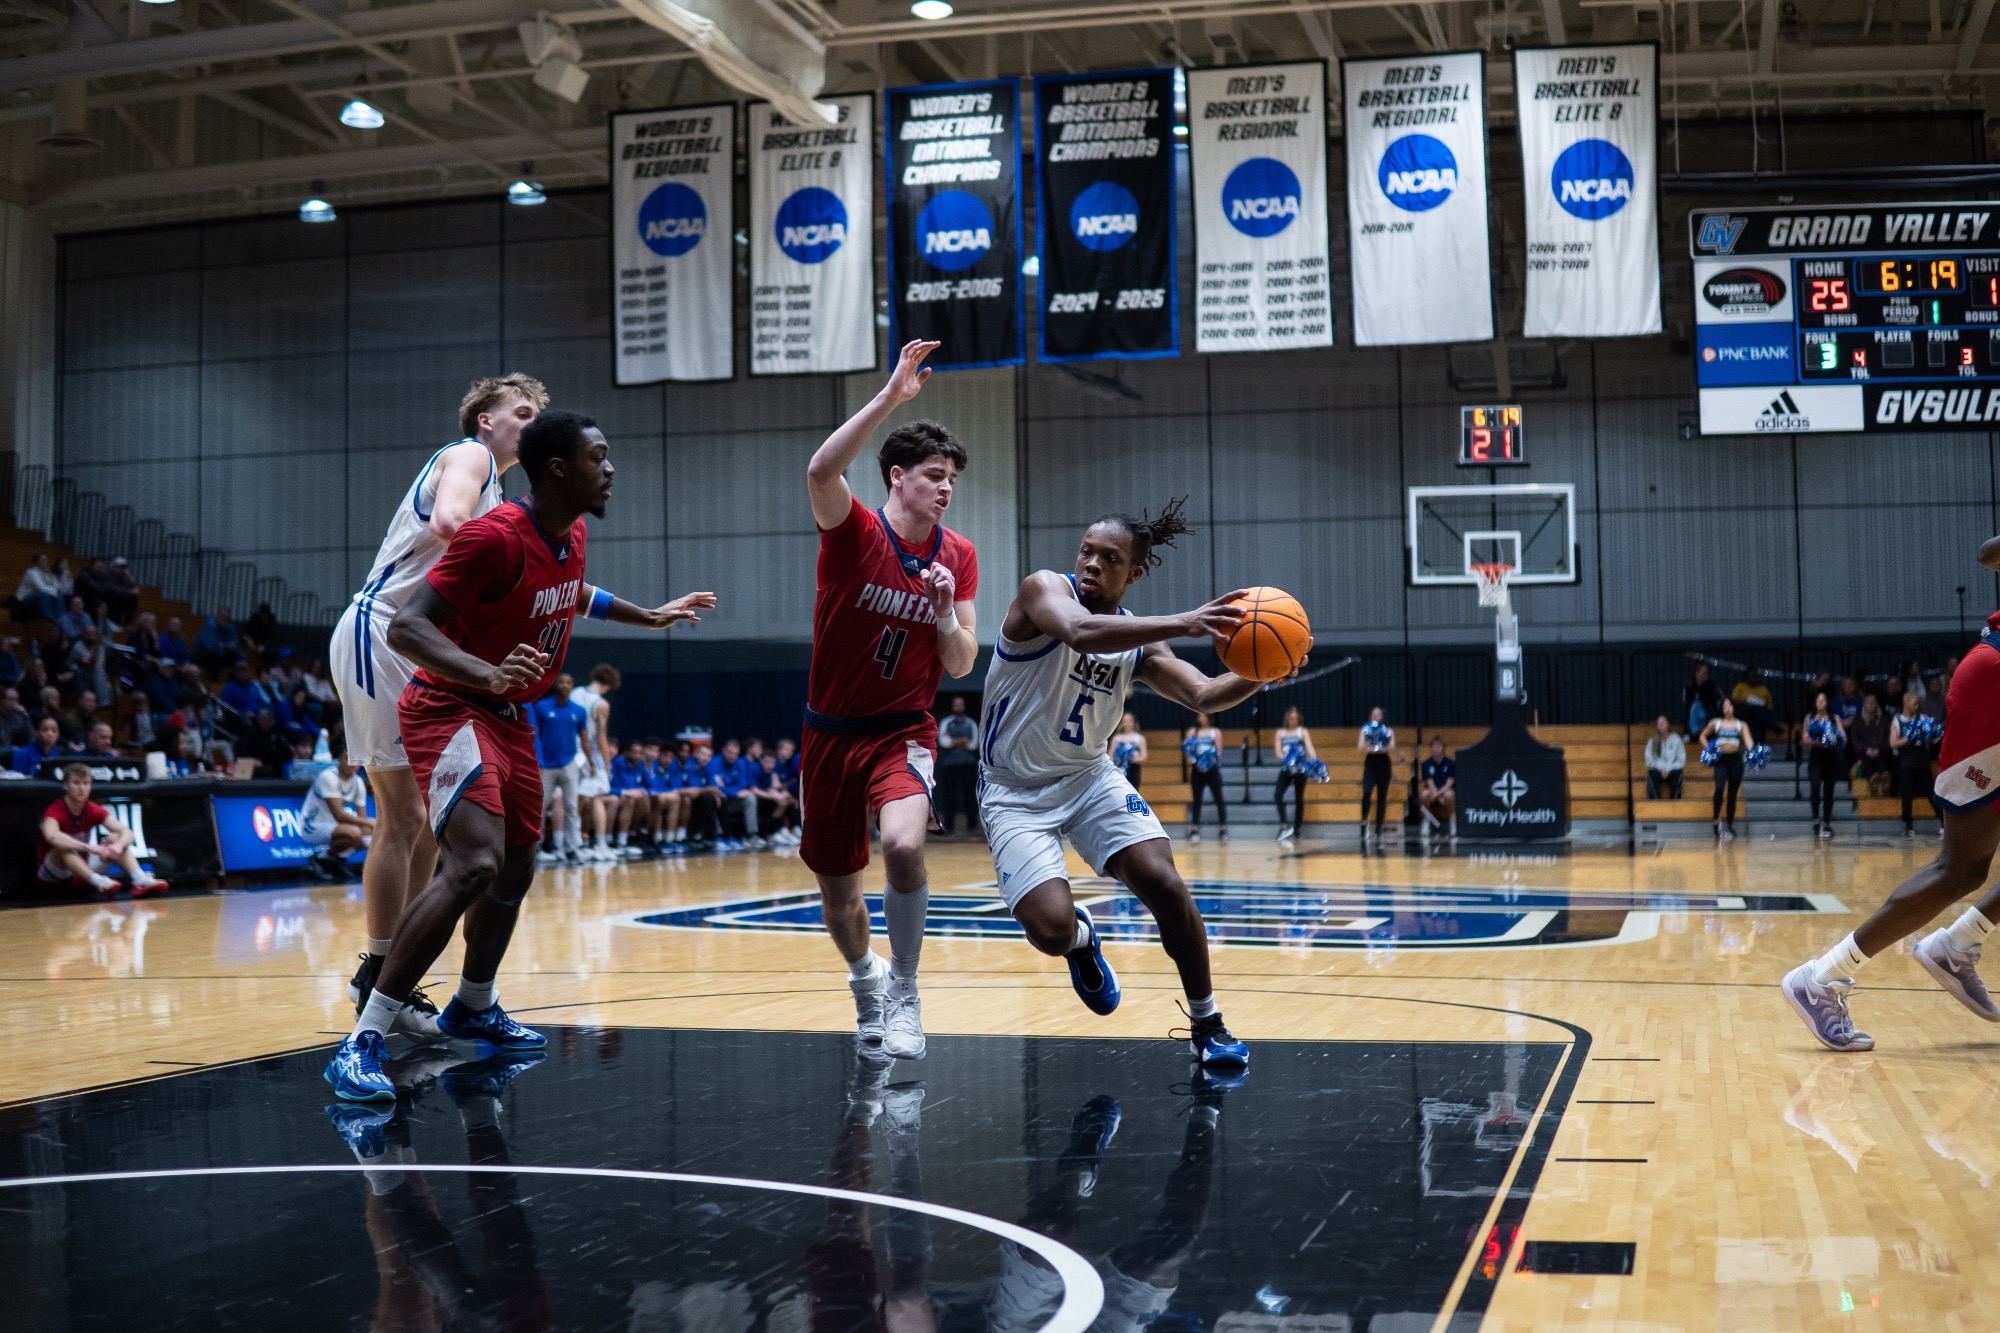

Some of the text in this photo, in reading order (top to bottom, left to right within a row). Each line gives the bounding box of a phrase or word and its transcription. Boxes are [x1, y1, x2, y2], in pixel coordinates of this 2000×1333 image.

[1383, 65, 1442, 85] MEN'S
[1557, 56, 1616, 76] MEN'S
[1063, 82, 1149, 102] WOMEN'S
[1226, 74, 1286, 95] MEN'S
[1358, 84, 1470, 107] BASKETBALL
[1534, 79, 1641, 100] BASKETBALL
[910, 93, 992, 117] WOMEN'S
[1049, 101, 1159, 124] BASKETBALL
[1204, 97, 1312, 119] BASKETBALL
[1554, 102, 1623, 123] ELITE 8
[635, 117, 712, 138] WOMEN'S
[900, 114, 1004, 140] BASKETBALL
[1372, 107, 1458, 128] REGIONAL
[762, 127, 857, 151] BASKETBALL
[1060, 122, 1147, 142] NATIONAL
[1218, 121, 1300, 141] REGIONAL
[622, 136, 722, 160] BASKETBALL
[912, 138, 992, 162] NATIONAL
[1050, 140, 1160, 163] CHAMPIONS
[633, 157, 710, 179] REGIONAL
[780, 151, 842, 171] ELITE 8
[902, 160, 1002, 185] CHAMPIONS
[1386, 168, 1457, 195] NCAA
[1561, 178, 1632, 203] NCAA
[1231, 196, 1300, 220] NCAA
[646, 217, 705, 240] NCAA
[783, 223, 846, 247] NCAA
[1077, 213, 1138, 237] NCAA
[1768, 215, 1872, 246] GRAND
[1885, 212, 1990, 243] VALLEY
[925, 228, 992, 253] NCAA
[1804, 261, 1844, 277] HOME
[1880, 259, 1957, 291] 6:19
[1050, 292, 1099, 312] 2024
[1116, 289, 1166, 310] 2025
[1811, 280, 1848, 311] 25
[1824, 313, 1858, 326] BONUS
[1882, 305, 1919, 317] PERIOD
[1965, 311, 1998, 323] BONUS
[1805, 332, 1837, 344] FOULS
[1874, 330, 1912, 343] PLAYER
[1927, 329, 1959, 341] FOULS
[1719, 345, 1789, 361] PNC BANK
[1820, 342, 1838, 370] 3
[1853, 349, 1867, 367] 4
[1961, 348, 1973, 365] 3
[1850, 367, 1870, 379] TOL
[1958, 365, 1977, 377] TOL
[1755, 415, 1810, 431] adidas
[1472, 428, 1512, 460] 21
[873, 624, 909, 680] 4
[1059, 693, 1095, 747] 5
[1465, 808, 1556, 827] Trinity Health
